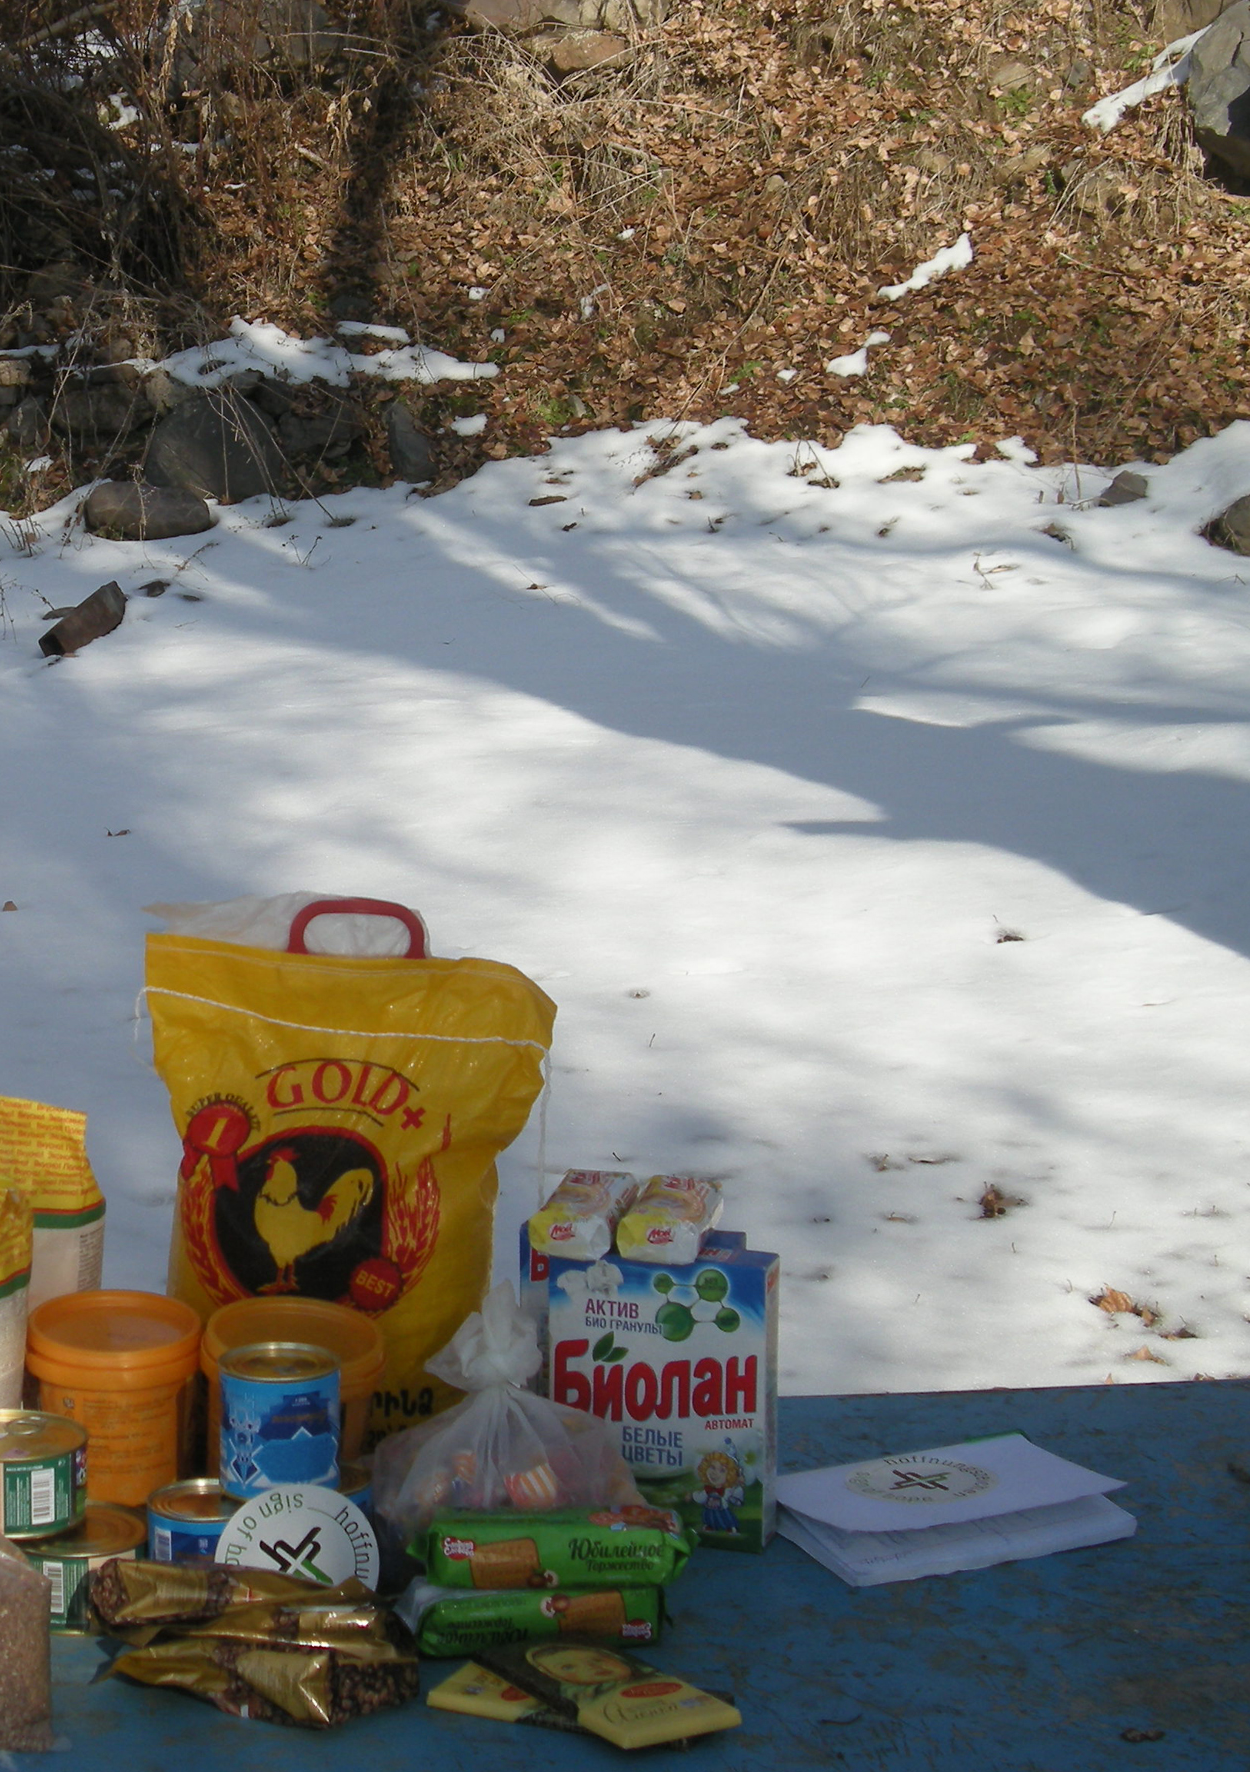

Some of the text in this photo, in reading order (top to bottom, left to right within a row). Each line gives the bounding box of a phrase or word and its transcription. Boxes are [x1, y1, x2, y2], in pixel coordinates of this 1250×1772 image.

[355, 1270, 396, 1300] BEST
[585, 1299, 639, 1319] АКТИВ
[585, 1317, 663, 1335] БИО ГРАНУЛЫ
[554, 1339, 757, 1422] Биолан
[705, 1419, 754, 1431] АВТОМАТ
[622, 1426, 682, 1449] БЕЛЫЕ
[622, 1444, 682, 1467] ЦВЕТЫ
[259, 1492, 304, 1519] sign
[237, 1516, 258, 1543] of
